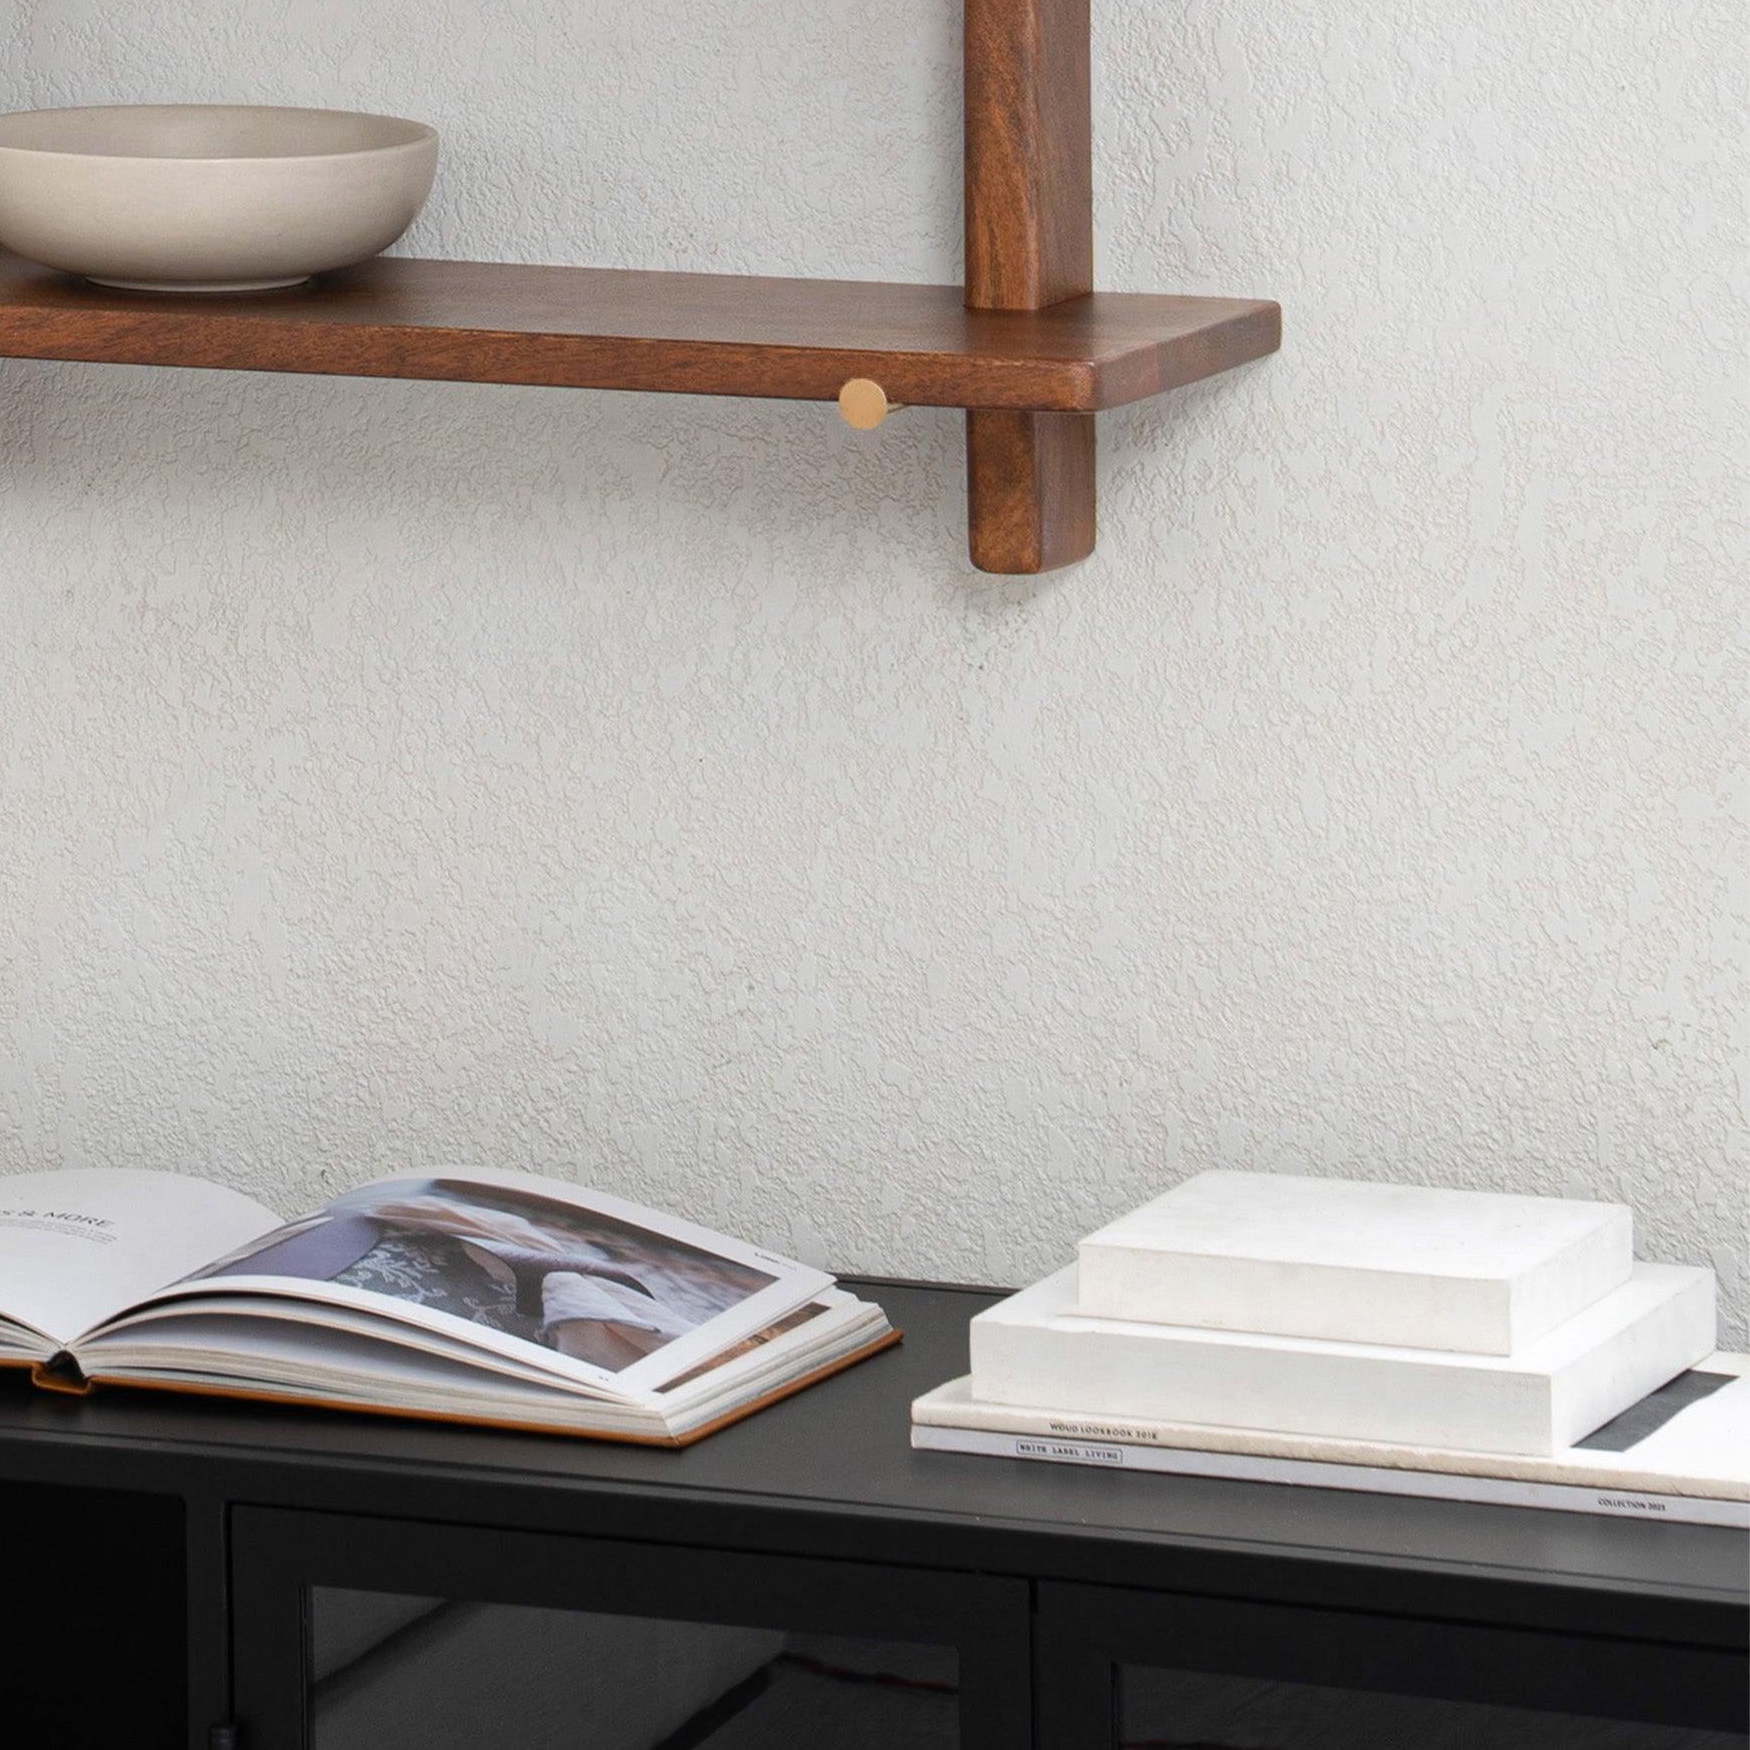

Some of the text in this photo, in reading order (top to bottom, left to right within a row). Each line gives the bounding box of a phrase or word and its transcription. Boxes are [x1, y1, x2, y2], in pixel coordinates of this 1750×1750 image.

[1081, 1425, 1133, 1438] LOOKBOOK
[1052, 1446, 1080, 1457] LABEL
[1085, 1449, 1118, 1460] LIVING
